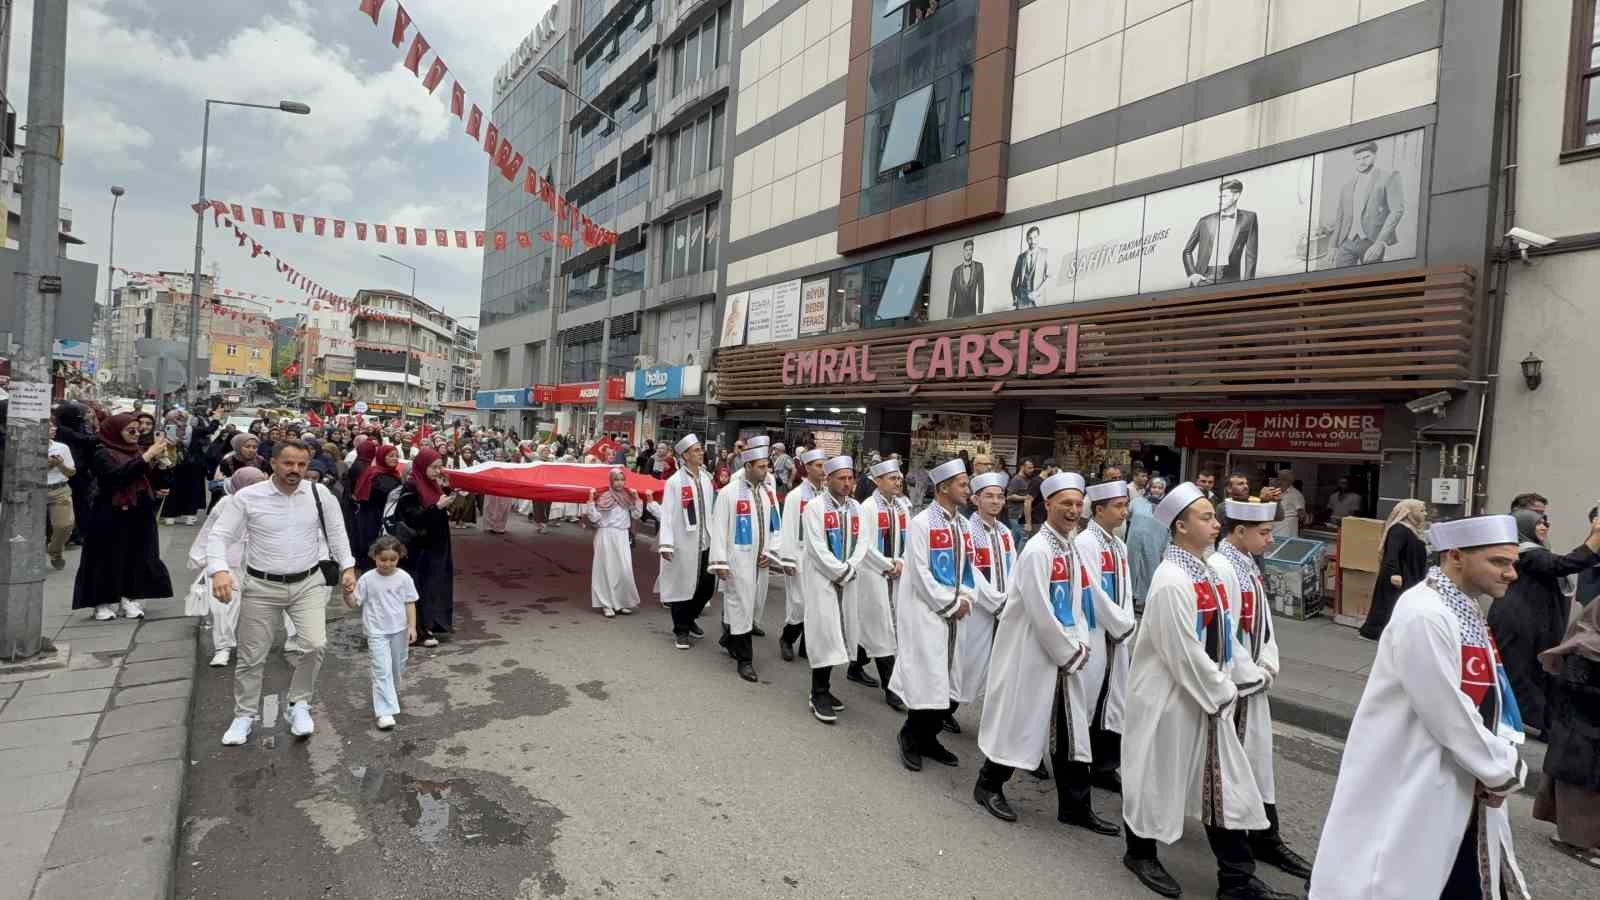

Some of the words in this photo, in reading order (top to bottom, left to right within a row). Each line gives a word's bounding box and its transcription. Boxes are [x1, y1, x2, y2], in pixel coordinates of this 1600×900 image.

[782, 344, 877, 386] EMRAL
[905, 322, 1079, 395] ÇARŞISI
[645, 370, 668, 386] beko
[1264, 413, 1300, 429] MİNİ
[1305, 412, 1375, 429] DÖNER
[1288, 431, 1313, 439] USTA
